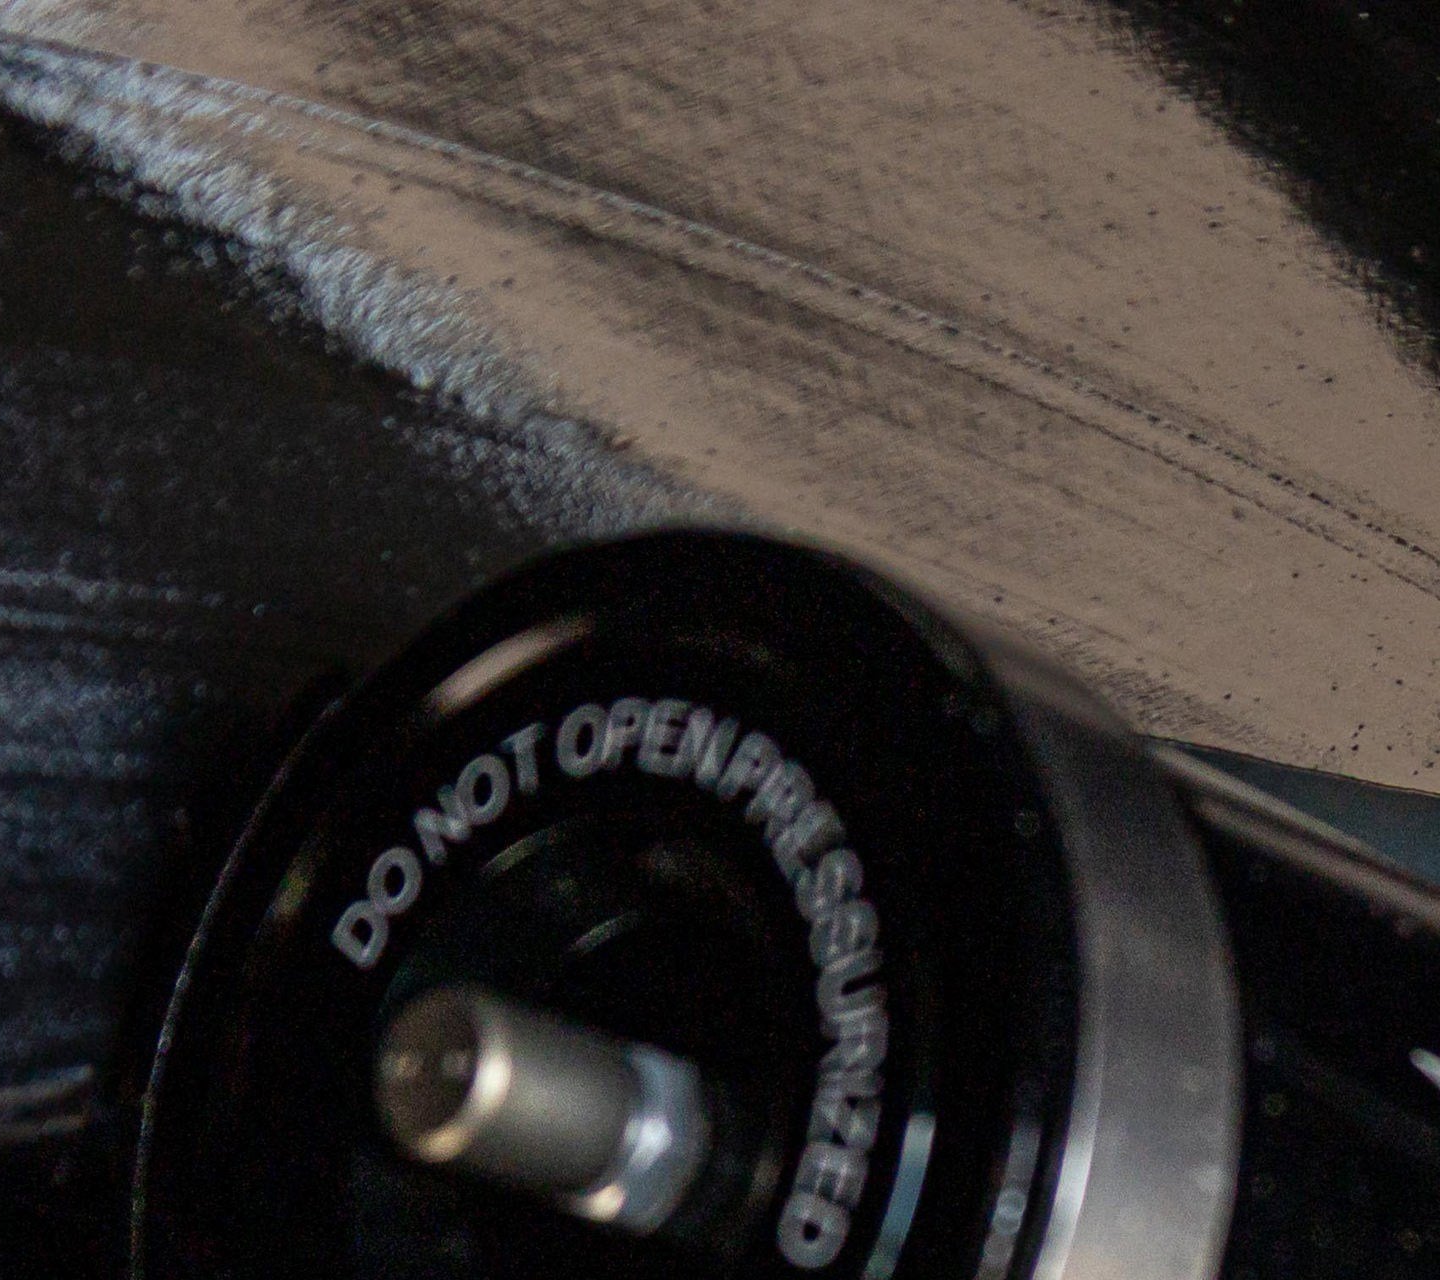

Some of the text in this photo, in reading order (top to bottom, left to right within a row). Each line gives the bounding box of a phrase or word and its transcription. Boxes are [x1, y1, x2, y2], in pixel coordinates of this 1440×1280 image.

[331, 697, 889, 1269] DO NOT OPEN PRESSURIZED
